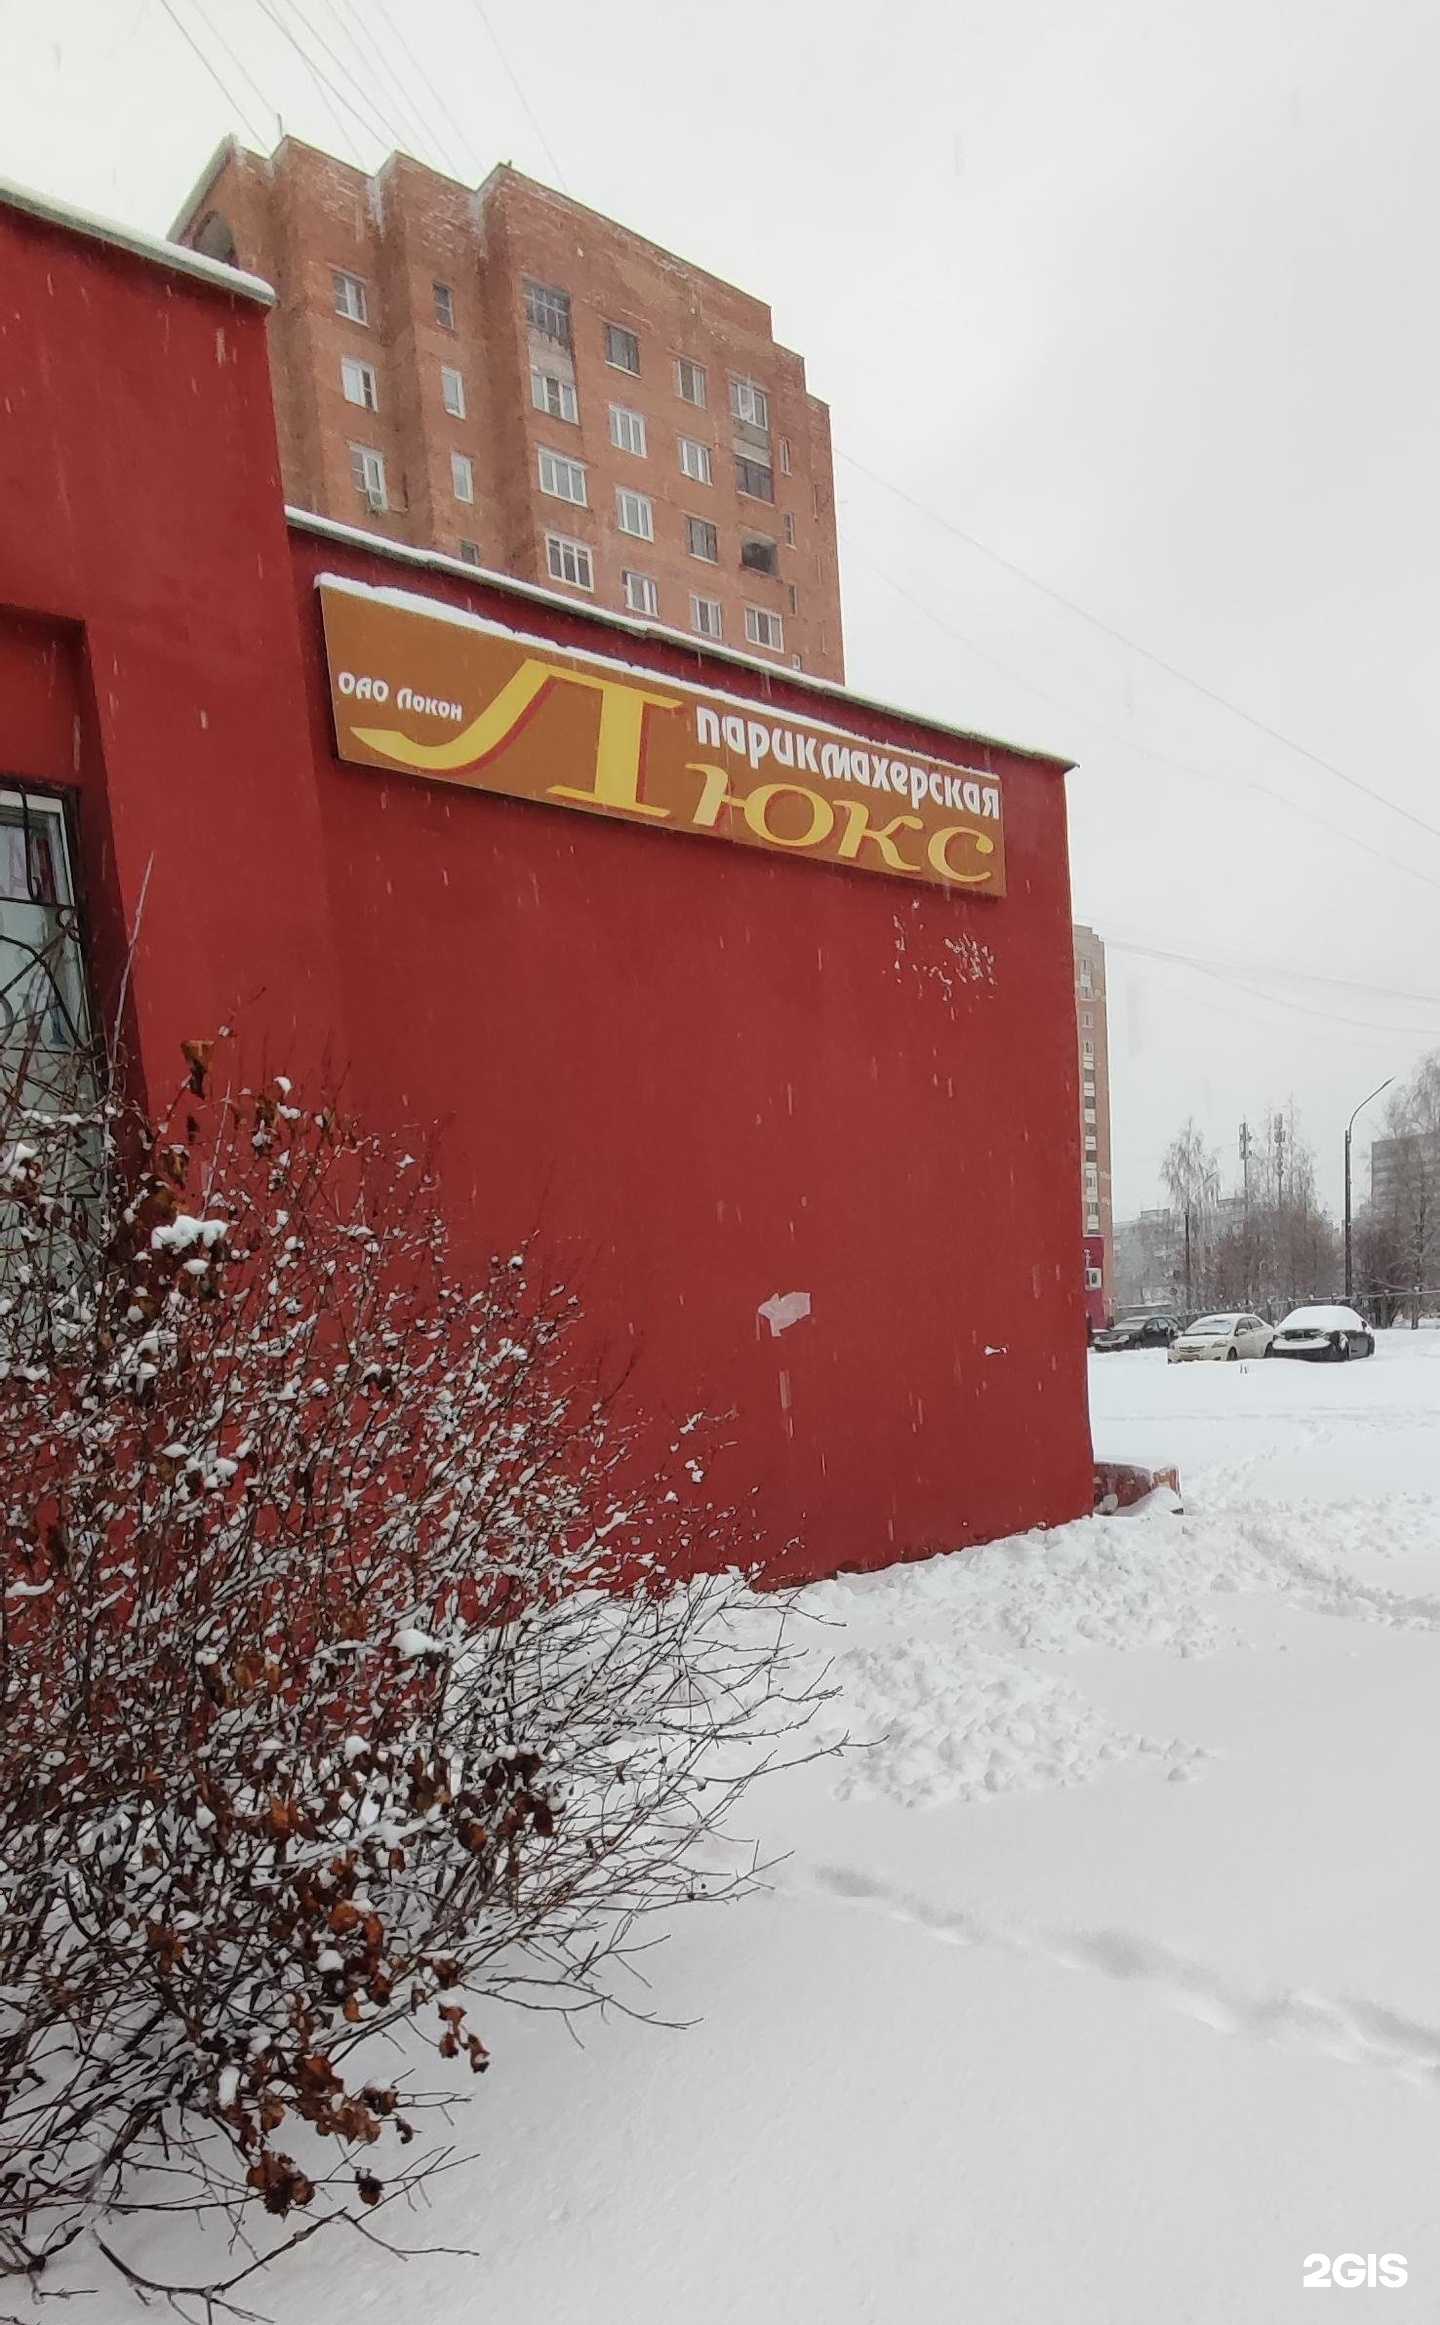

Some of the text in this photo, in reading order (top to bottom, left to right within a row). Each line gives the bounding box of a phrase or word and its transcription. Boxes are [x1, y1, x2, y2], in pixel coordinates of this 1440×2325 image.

[338, 671, 463, 722] ОАО Локон
[696, 705, 1000, 820] парикмахерская
